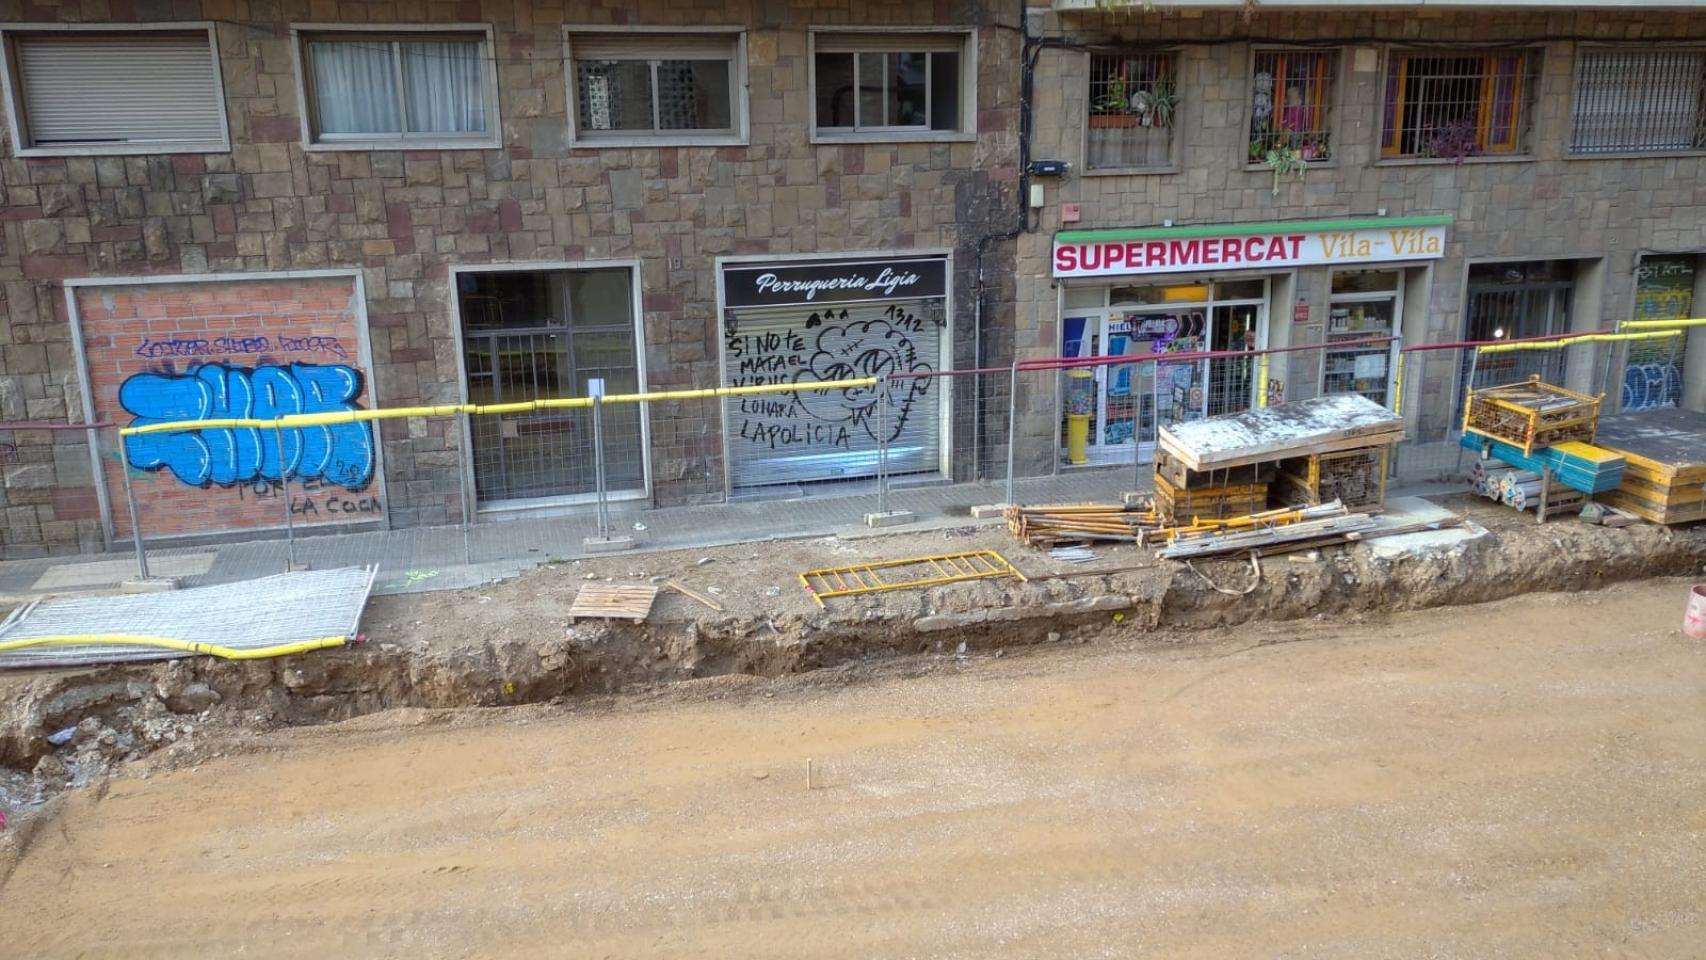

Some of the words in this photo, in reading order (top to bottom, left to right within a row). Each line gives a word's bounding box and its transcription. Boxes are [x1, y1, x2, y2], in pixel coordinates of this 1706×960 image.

[1056, 235, 1306, 272] SUPERMERCAT
[865, 267, 921, 295] Ligia
[884, 304, 924, 332] 1312
[290, 497, 318, 515] LA
